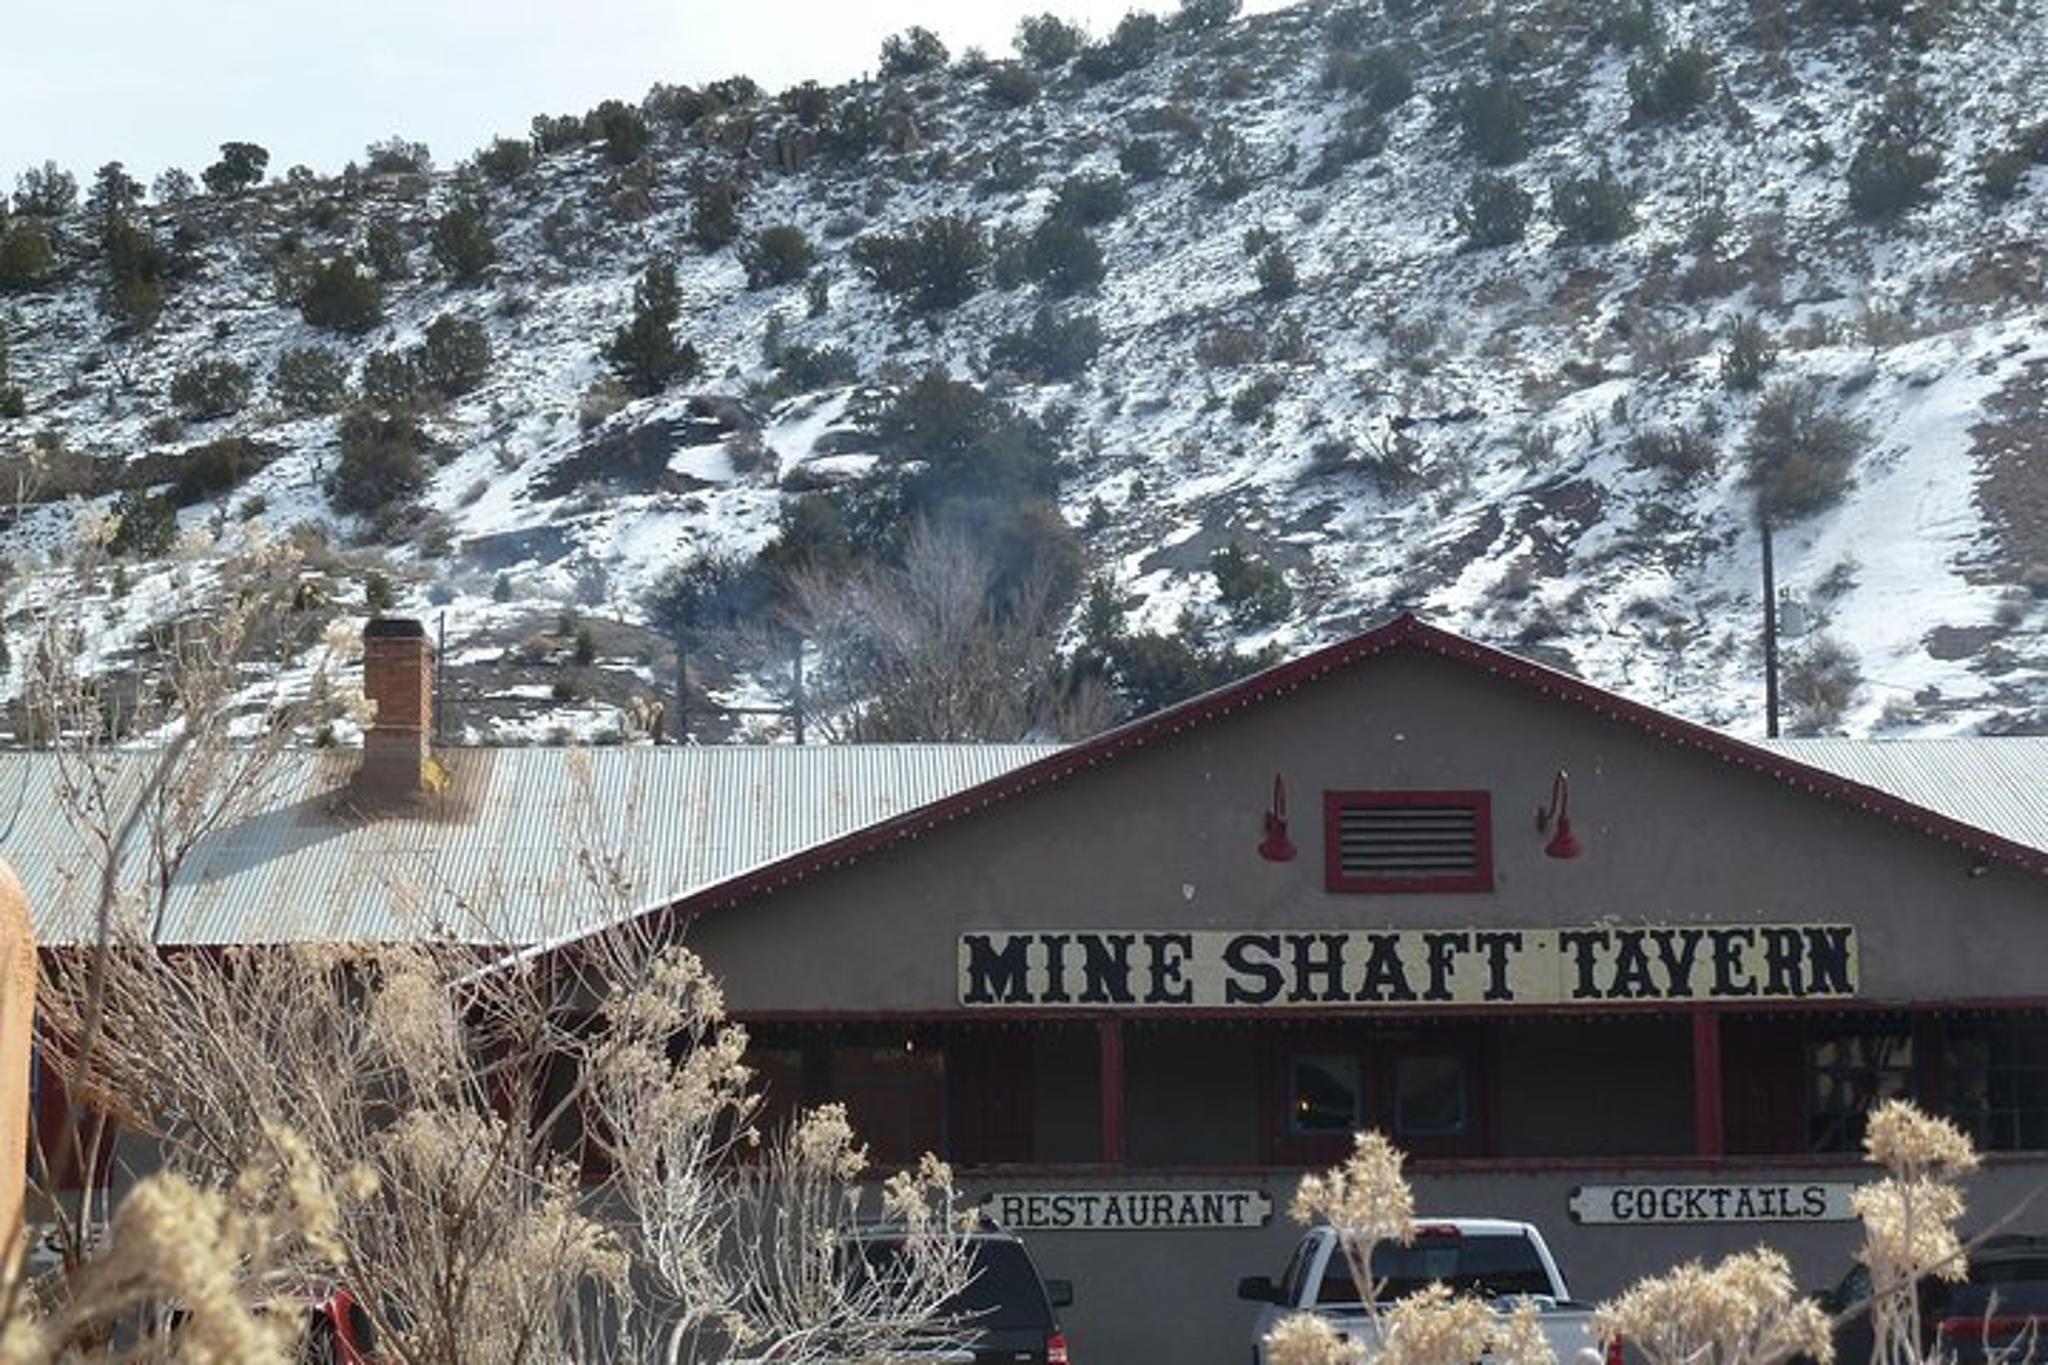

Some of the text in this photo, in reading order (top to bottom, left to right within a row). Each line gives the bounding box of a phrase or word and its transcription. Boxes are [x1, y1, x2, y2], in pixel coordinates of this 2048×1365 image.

[963, 927, 1853, 1004] MINE SHAFT TAVERN
[1001, 1194, 1250, 1227] RESTAURANT
[1611, 1187, 1827, 1219] COCKTAILS
